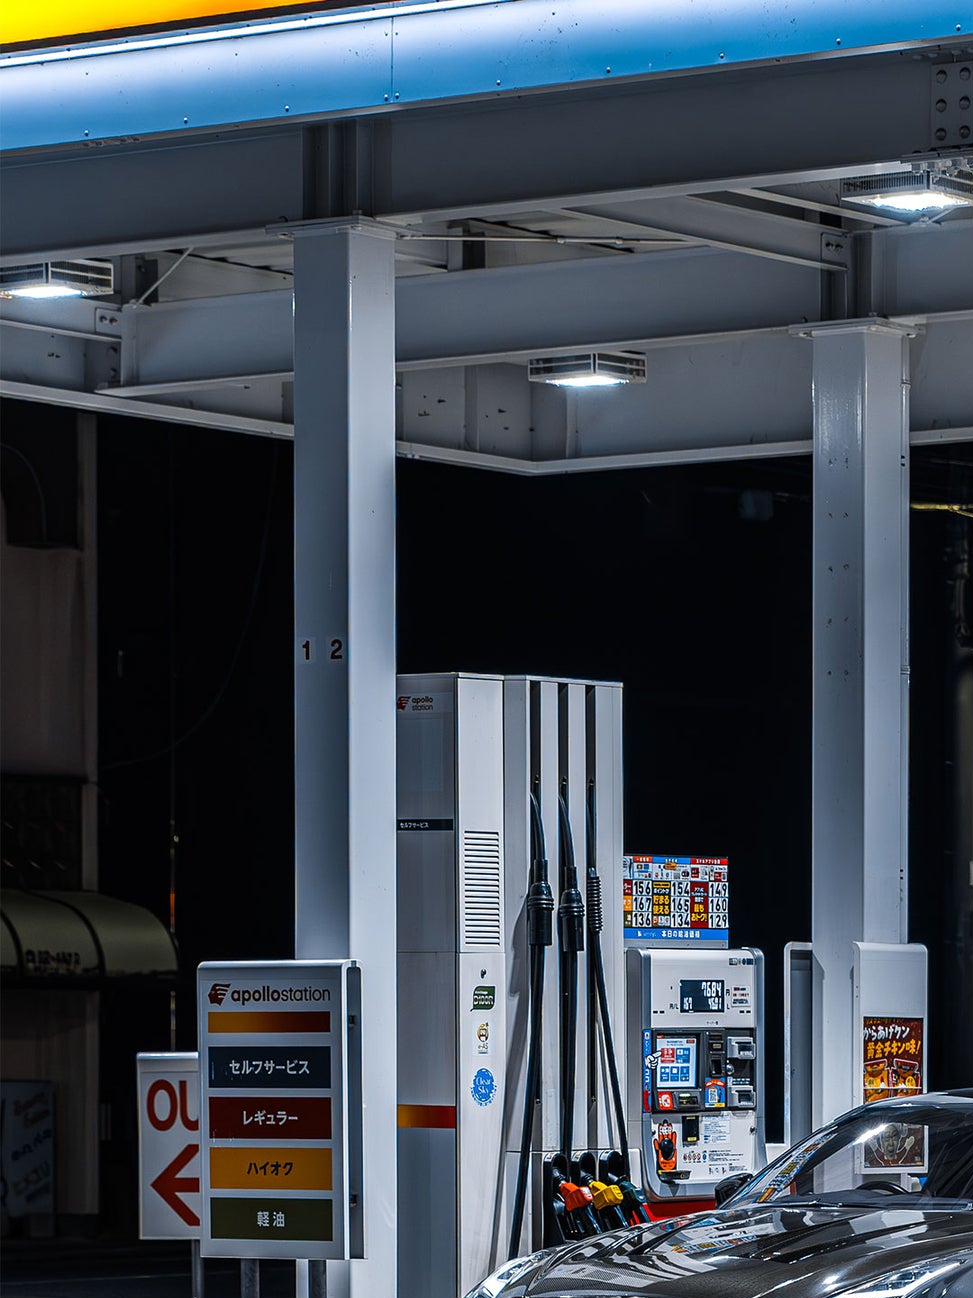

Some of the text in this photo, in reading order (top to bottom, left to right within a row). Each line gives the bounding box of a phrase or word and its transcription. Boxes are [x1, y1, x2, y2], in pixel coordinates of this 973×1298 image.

[302, 639, 343, 660] 1 2
[411, 696, 434, 705] apollo
[634, 881, 651, 895] 156
[671, 882, 690, 896] 154
[709, 883, 728, 897] 149
[634, 898, 652, 911] 167
[671, 898, 690, 912] 165
[709, 898, 728, 912] 160
[634, 913, 651, 926] 136
[671, 913, 690, 927] 134
[709, 914, 728, 928] 129
[231, 985, 331, 1006] apollostation
[863, 1024, 910, 1041] からあげクン
[867, 1039, 921, 1060] 黄金チキン味!
[229, 1060, 310, 1075] セルフサービス
[242, 1110, 298, 1126] レギュラー
[247, 1161, 293, 1176] ハイオク
[257, 1211, 285, 1227] 軽油
